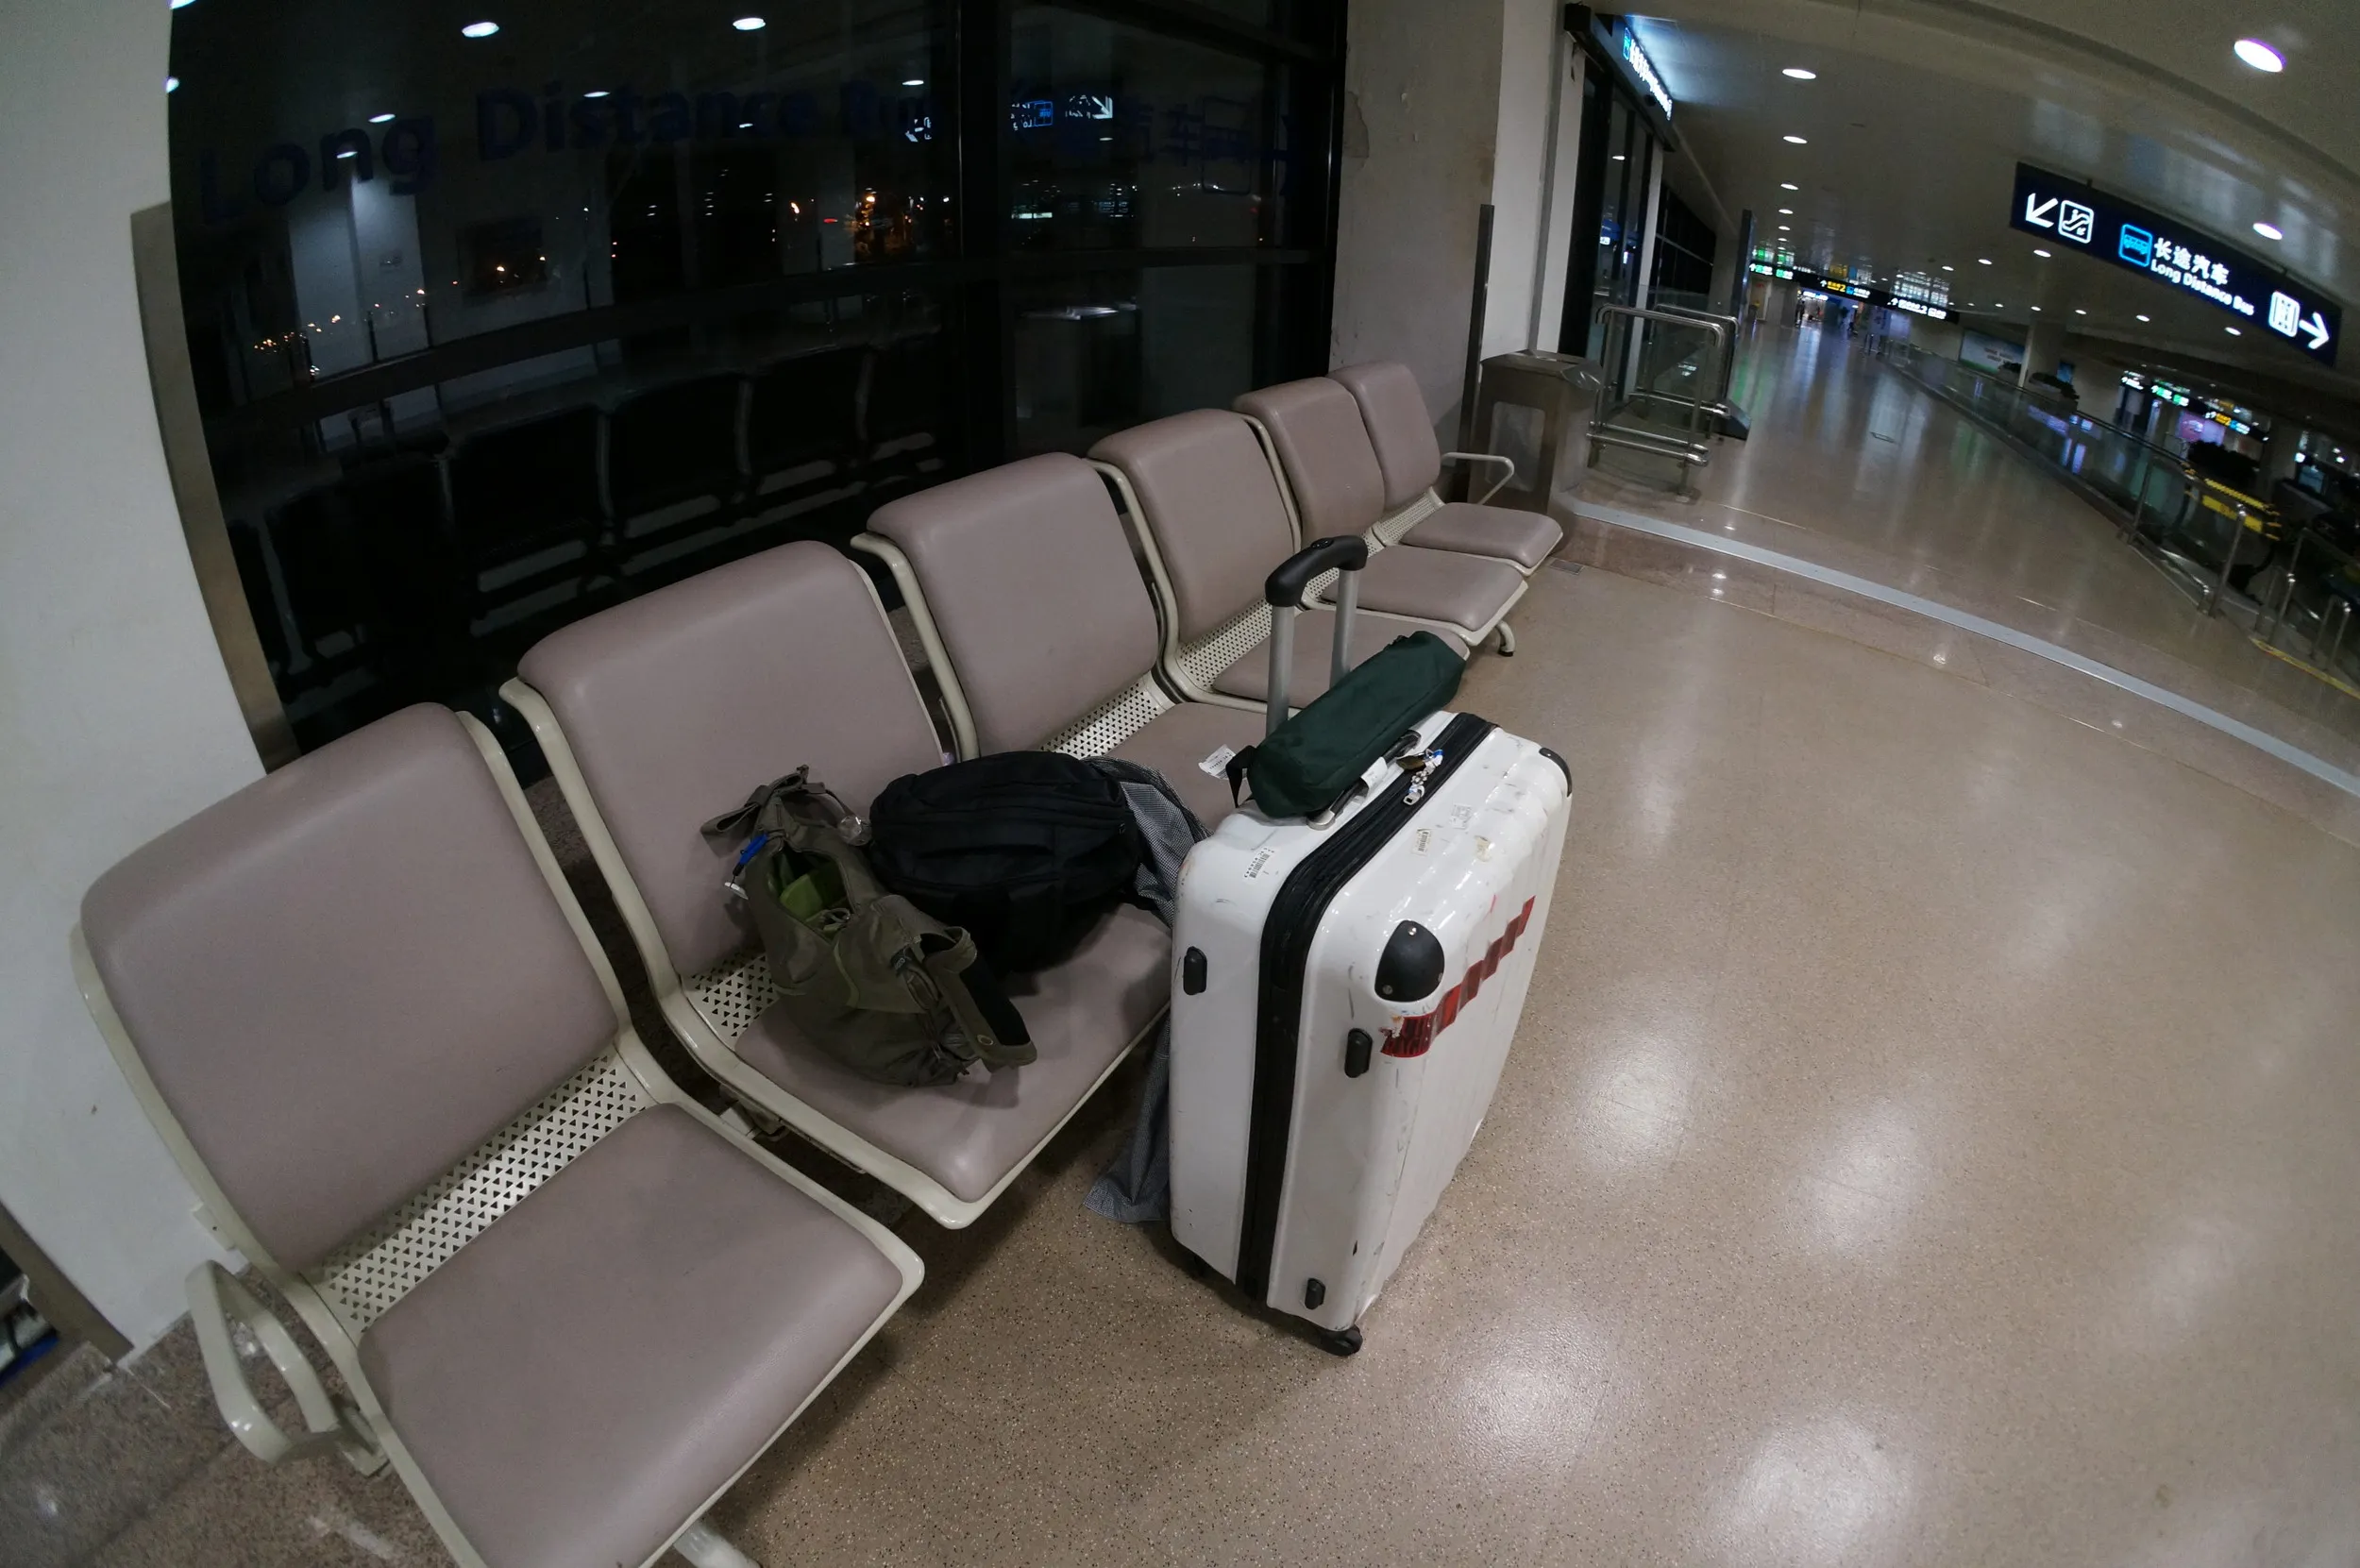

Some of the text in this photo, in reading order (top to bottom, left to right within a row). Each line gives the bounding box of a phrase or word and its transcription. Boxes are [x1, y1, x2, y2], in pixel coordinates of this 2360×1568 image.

[196, 114, 439, 226] Long
[474, 80, 818, 161] Distance
[2150, 259, 2254, 316] Long Distance Bus
[2153, 237, 2229, 285] 长途汽车
